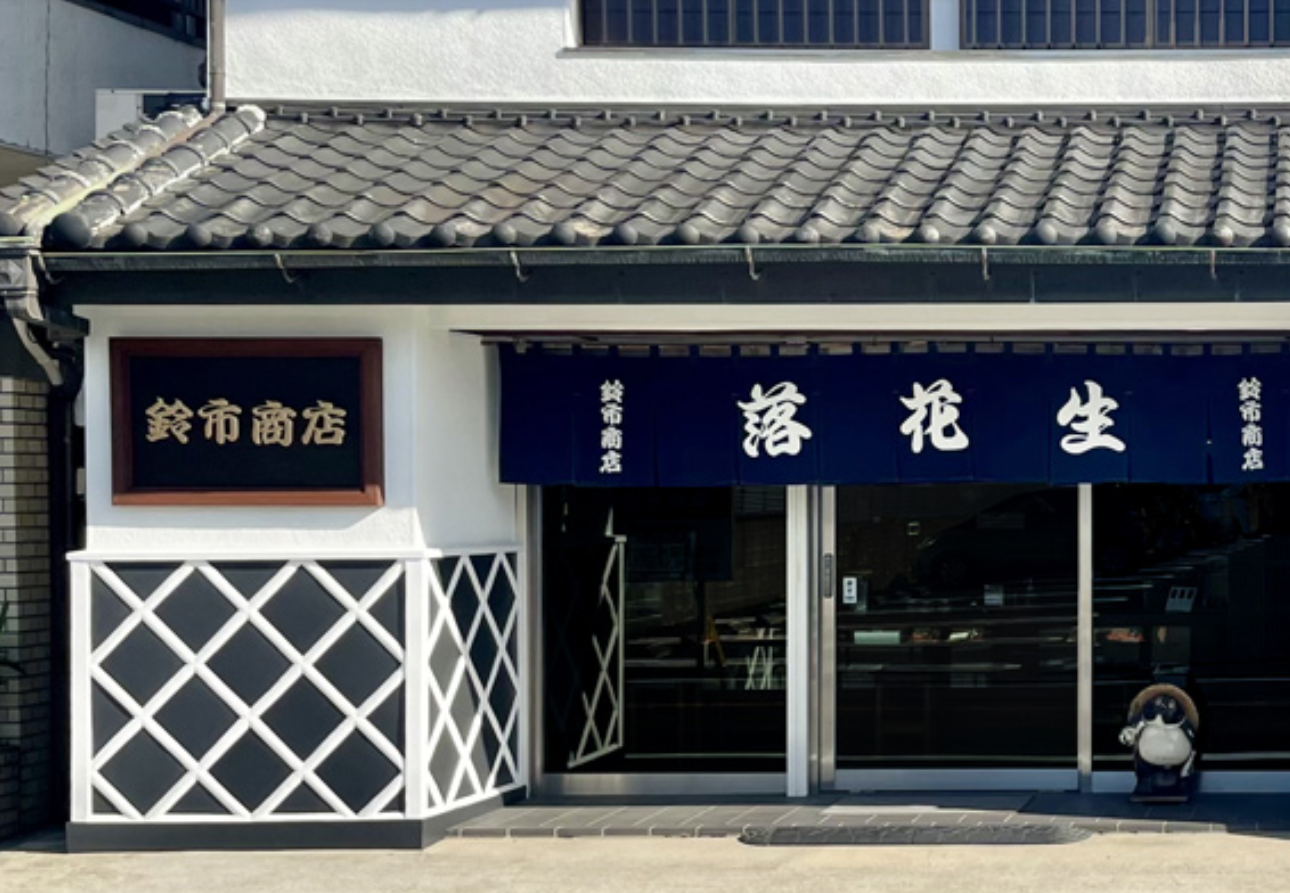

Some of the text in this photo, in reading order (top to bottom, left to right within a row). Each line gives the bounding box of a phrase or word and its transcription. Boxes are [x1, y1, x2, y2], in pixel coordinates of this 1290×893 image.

[145, 397, 347, 446] 鈴市商店
[599, 378, 624, 474] 鈴市商店
[737, 378, 1126, 458] 落花生
[1237, 376, 1264, 471] 鈴市商店
